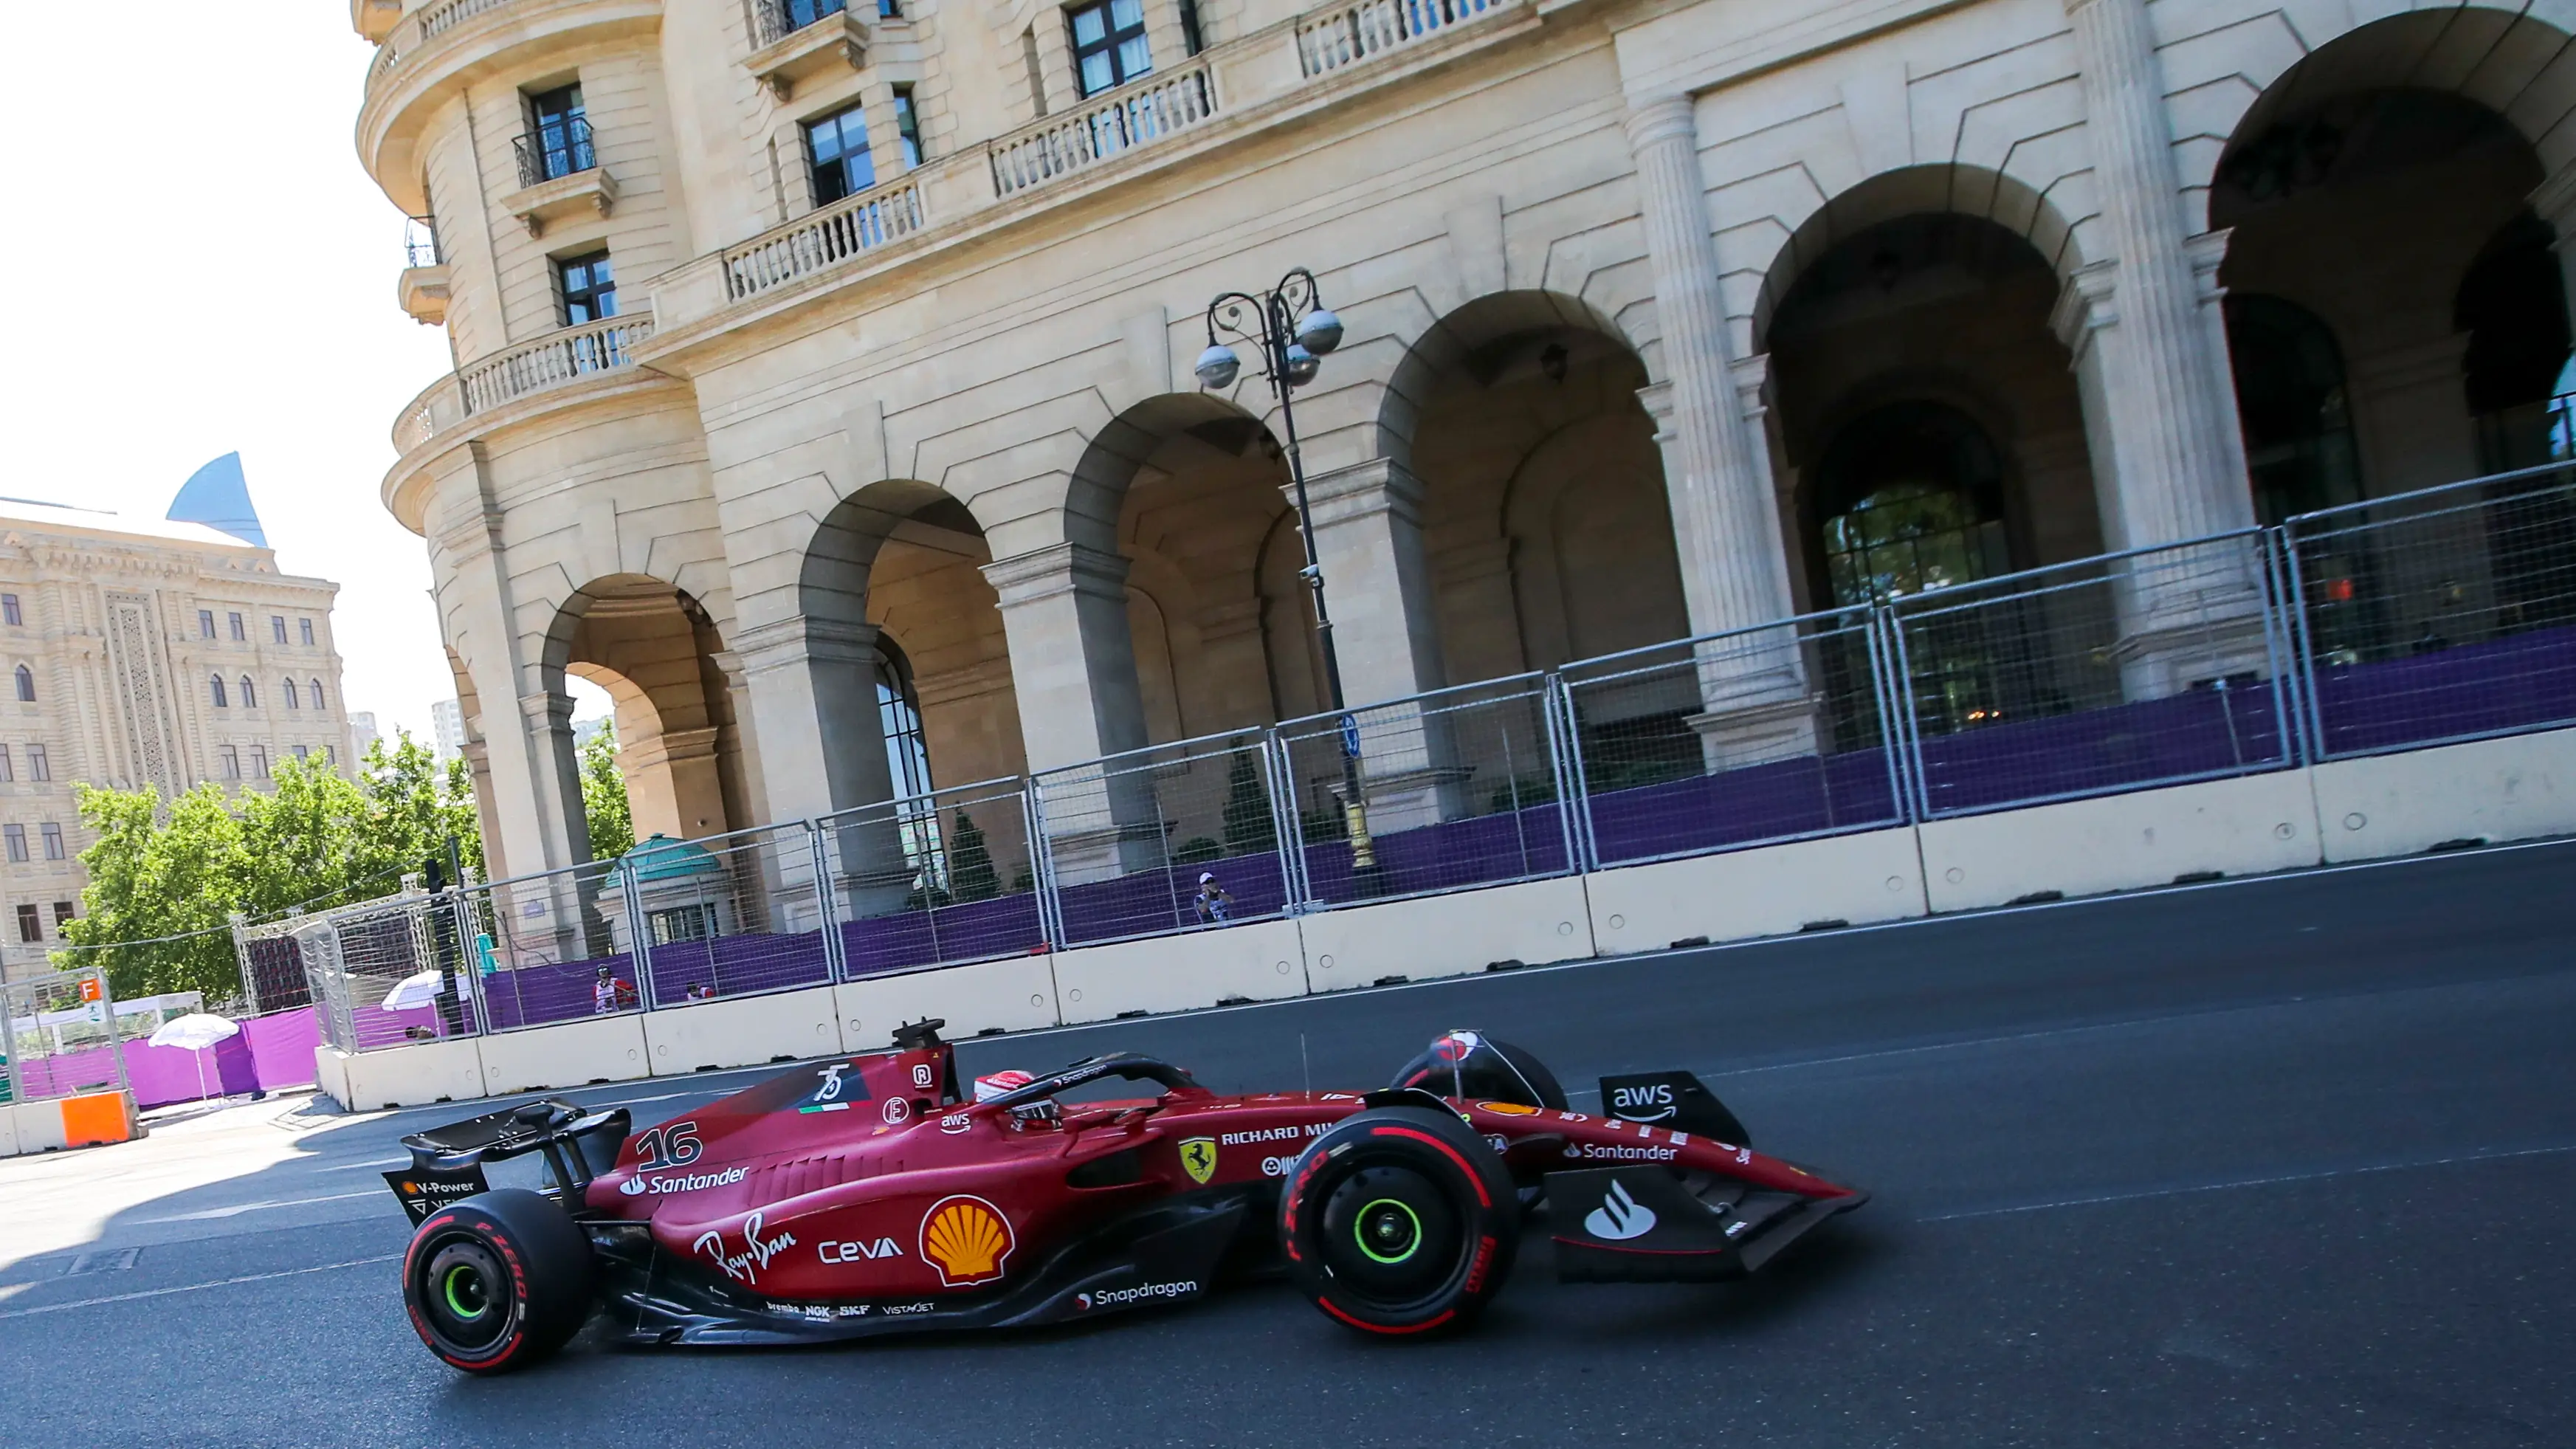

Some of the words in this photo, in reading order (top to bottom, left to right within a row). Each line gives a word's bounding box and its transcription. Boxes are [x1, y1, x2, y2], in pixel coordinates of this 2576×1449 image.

[81, 981, 94, 1000] F
[1063, 1064, 1107, 1084] Snapdragon
[1614, 1084, 1673, 1107] aws
[941, 1113, 971, 1127] aws
[1222, 1126, 1300, 1146] RICHARD
[636, 1121, 703, 1173] 16
[1583, 1143, 1678, 1160] Santander
[416, 1181, 475, 1194] V-Power
[648, 1166, 750, 1194] Santander
[1095, 1280, 1198, 1305] Snapdragon
[766, 1301, 800, 1314] brembo
[805, 1305, 830, 1318] NGK
[838, 1304, 870, 1317] SKF
